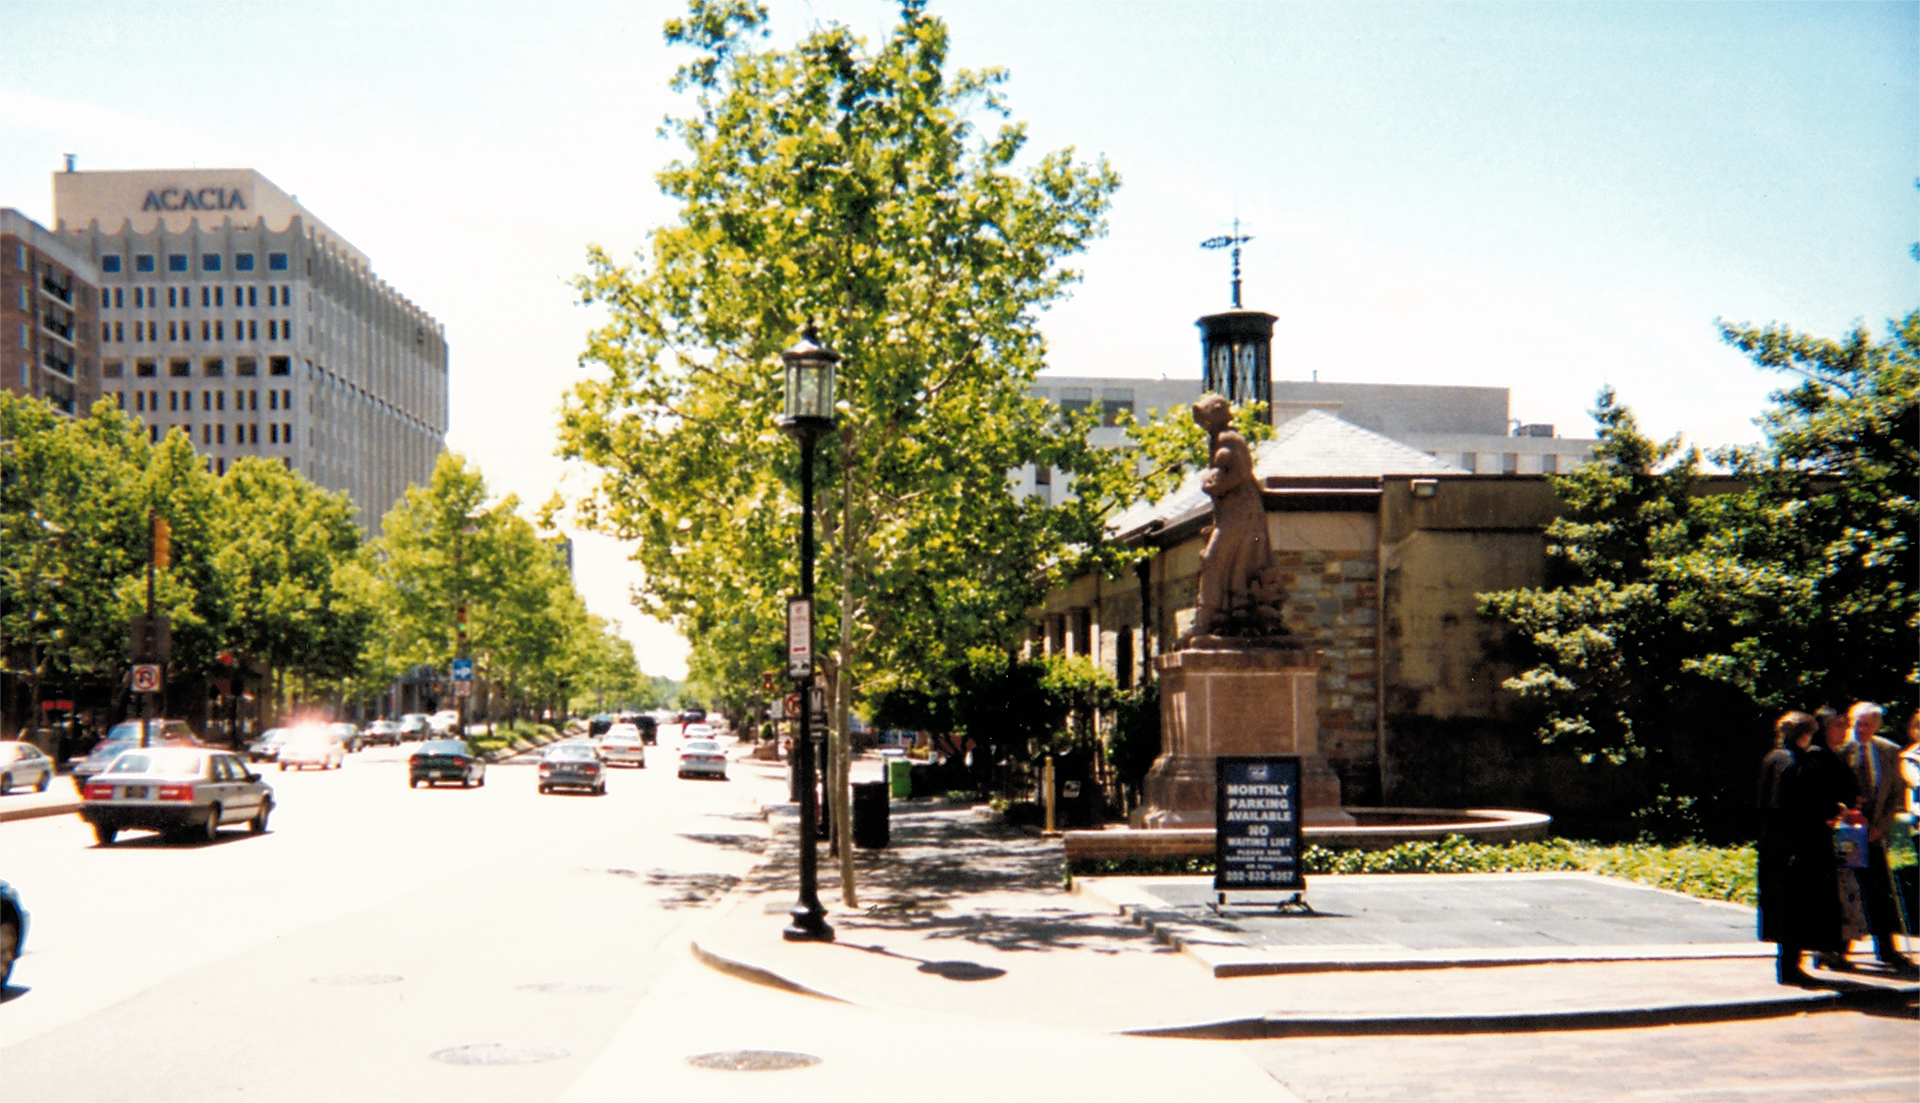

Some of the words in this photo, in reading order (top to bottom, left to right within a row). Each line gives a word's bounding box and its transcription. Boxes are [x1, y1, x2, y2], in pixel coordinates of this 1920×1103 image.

[142, 188, 246, 212] ACACIA
[1227, 784, 1289, 796] MONTHLY
[1228, 798, 1289, 810] PARKING
[1226, 811, 1292, 822] AVAILABLE
[1248, 825, 1269, 837] NO
[1227, 837, 1268, 847] WAITING
[1270, 837, 1292, 847] LIST
